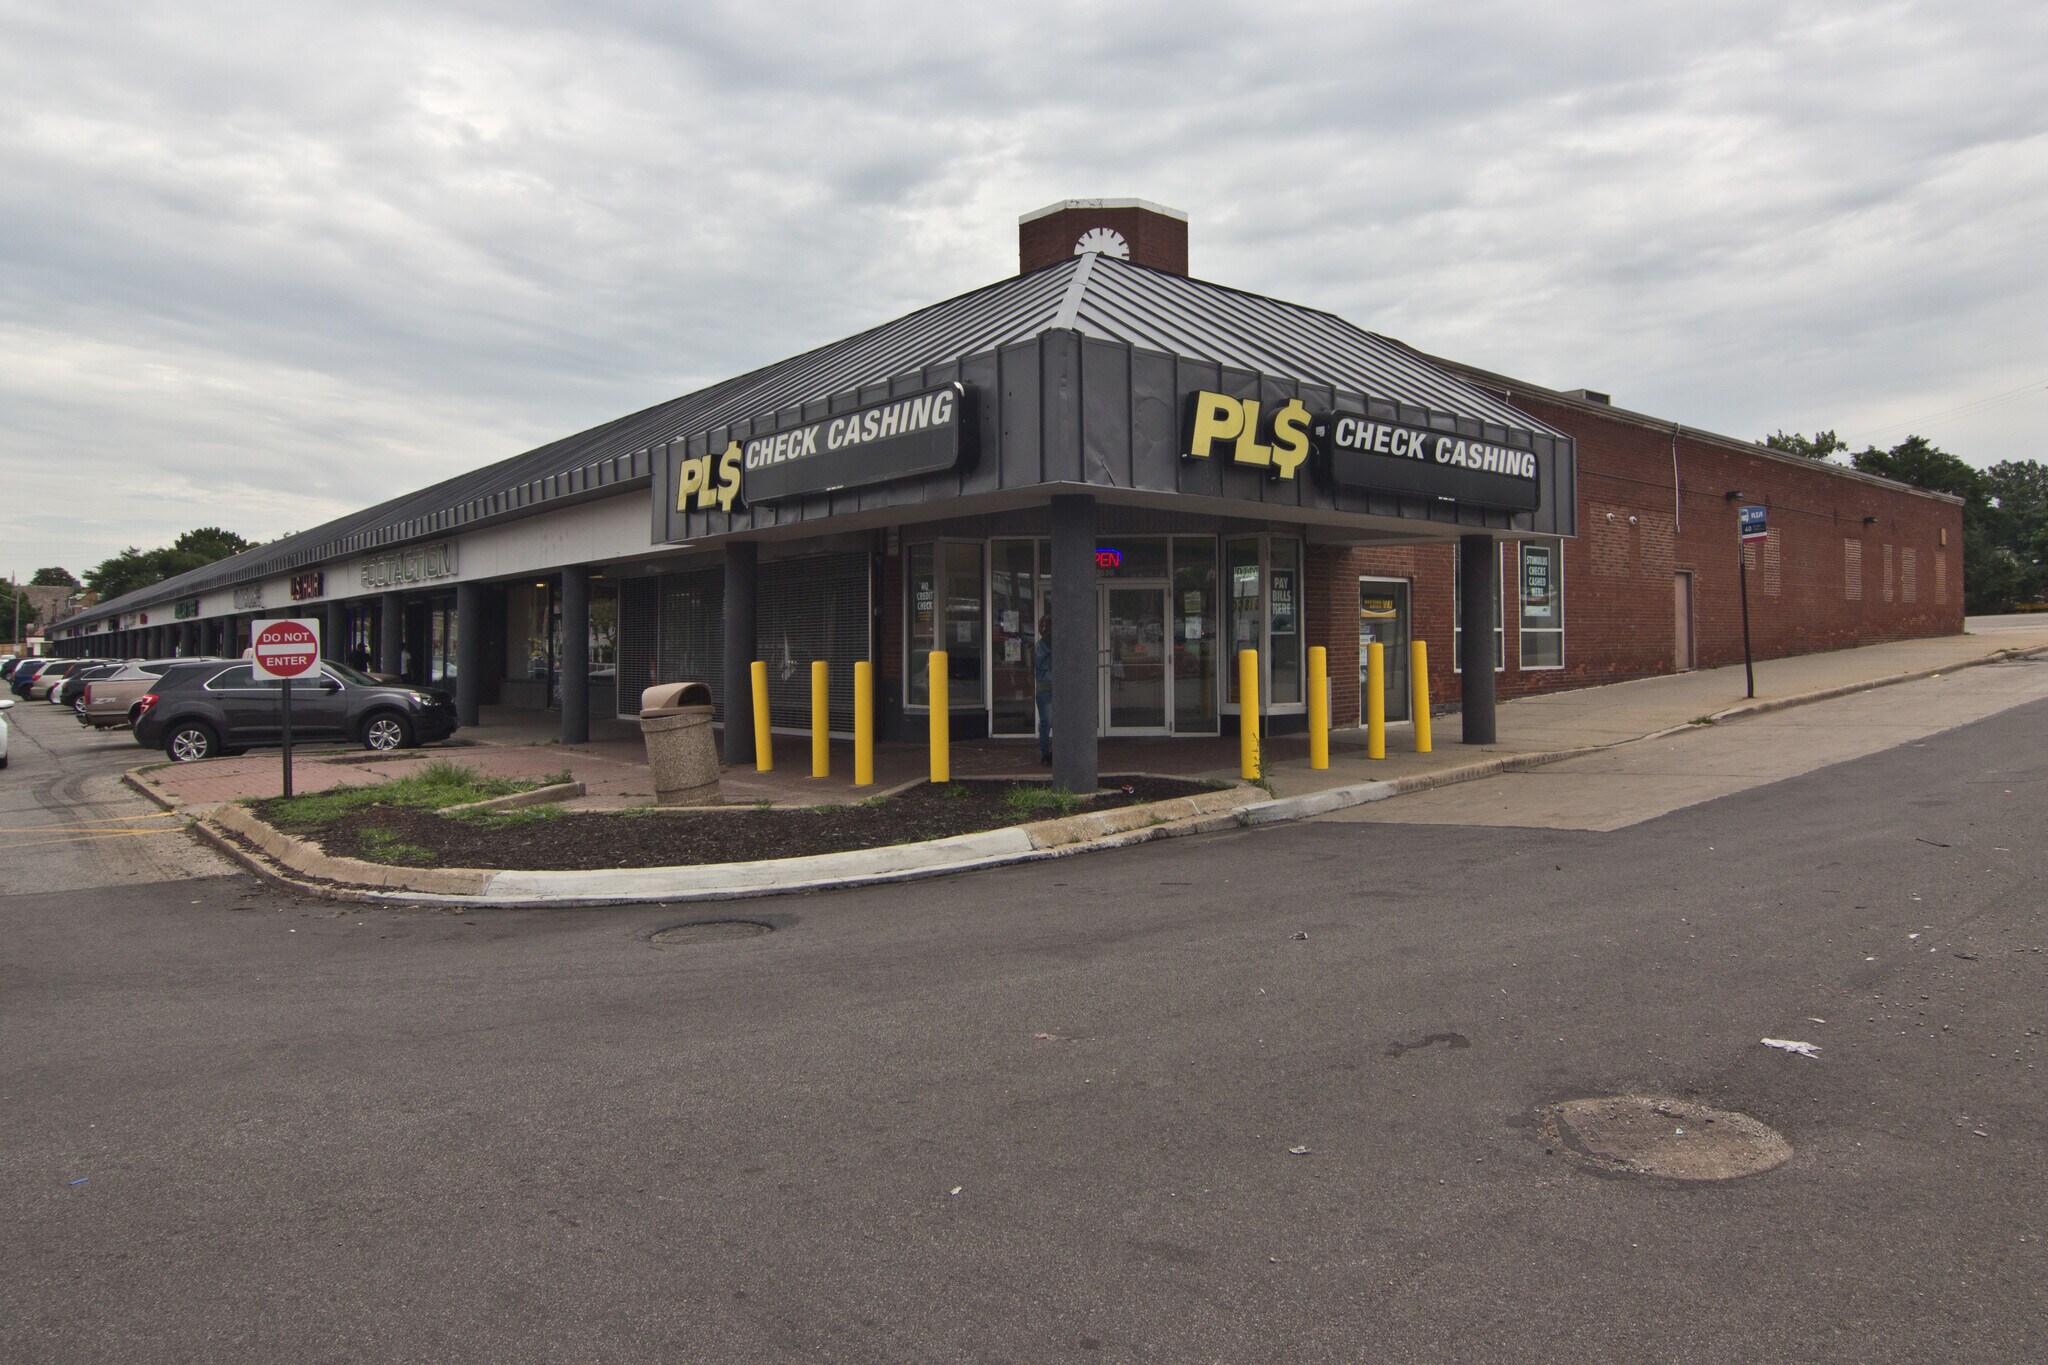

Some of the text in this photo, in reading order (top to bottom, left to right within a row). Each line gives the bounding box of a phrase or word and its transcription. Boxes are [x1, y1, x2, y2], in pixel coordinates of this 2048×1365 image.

[745, 389, 954, 470] CHECK CASHING
[1334, 417, 1536, 479] CHECK CASHING
[1751, 511, 1763, 519] RTA
[1095, 552, 1119, 567] PEN
[1526, 555, 1548, 566] STIMULUS
[360, 541, 454, 590] FOOTACTION
[1528, 566, 1546, 576] CHECKS
[1274, 577, 1288, 589] PAY
[1528, 576, 1547, 587] CASHED
[916, 591, 933, 601] CREDIT
[1272, 590, 1291, 602] BILLS
[1531, 587, 1544, 597] HERE
[917, 601, 933, 610] CHECK
[1272, 602, 1291, 615] HERE
[262, 632, 309, 643] DO NOT
[266, 656, 307, 667] ENTER
